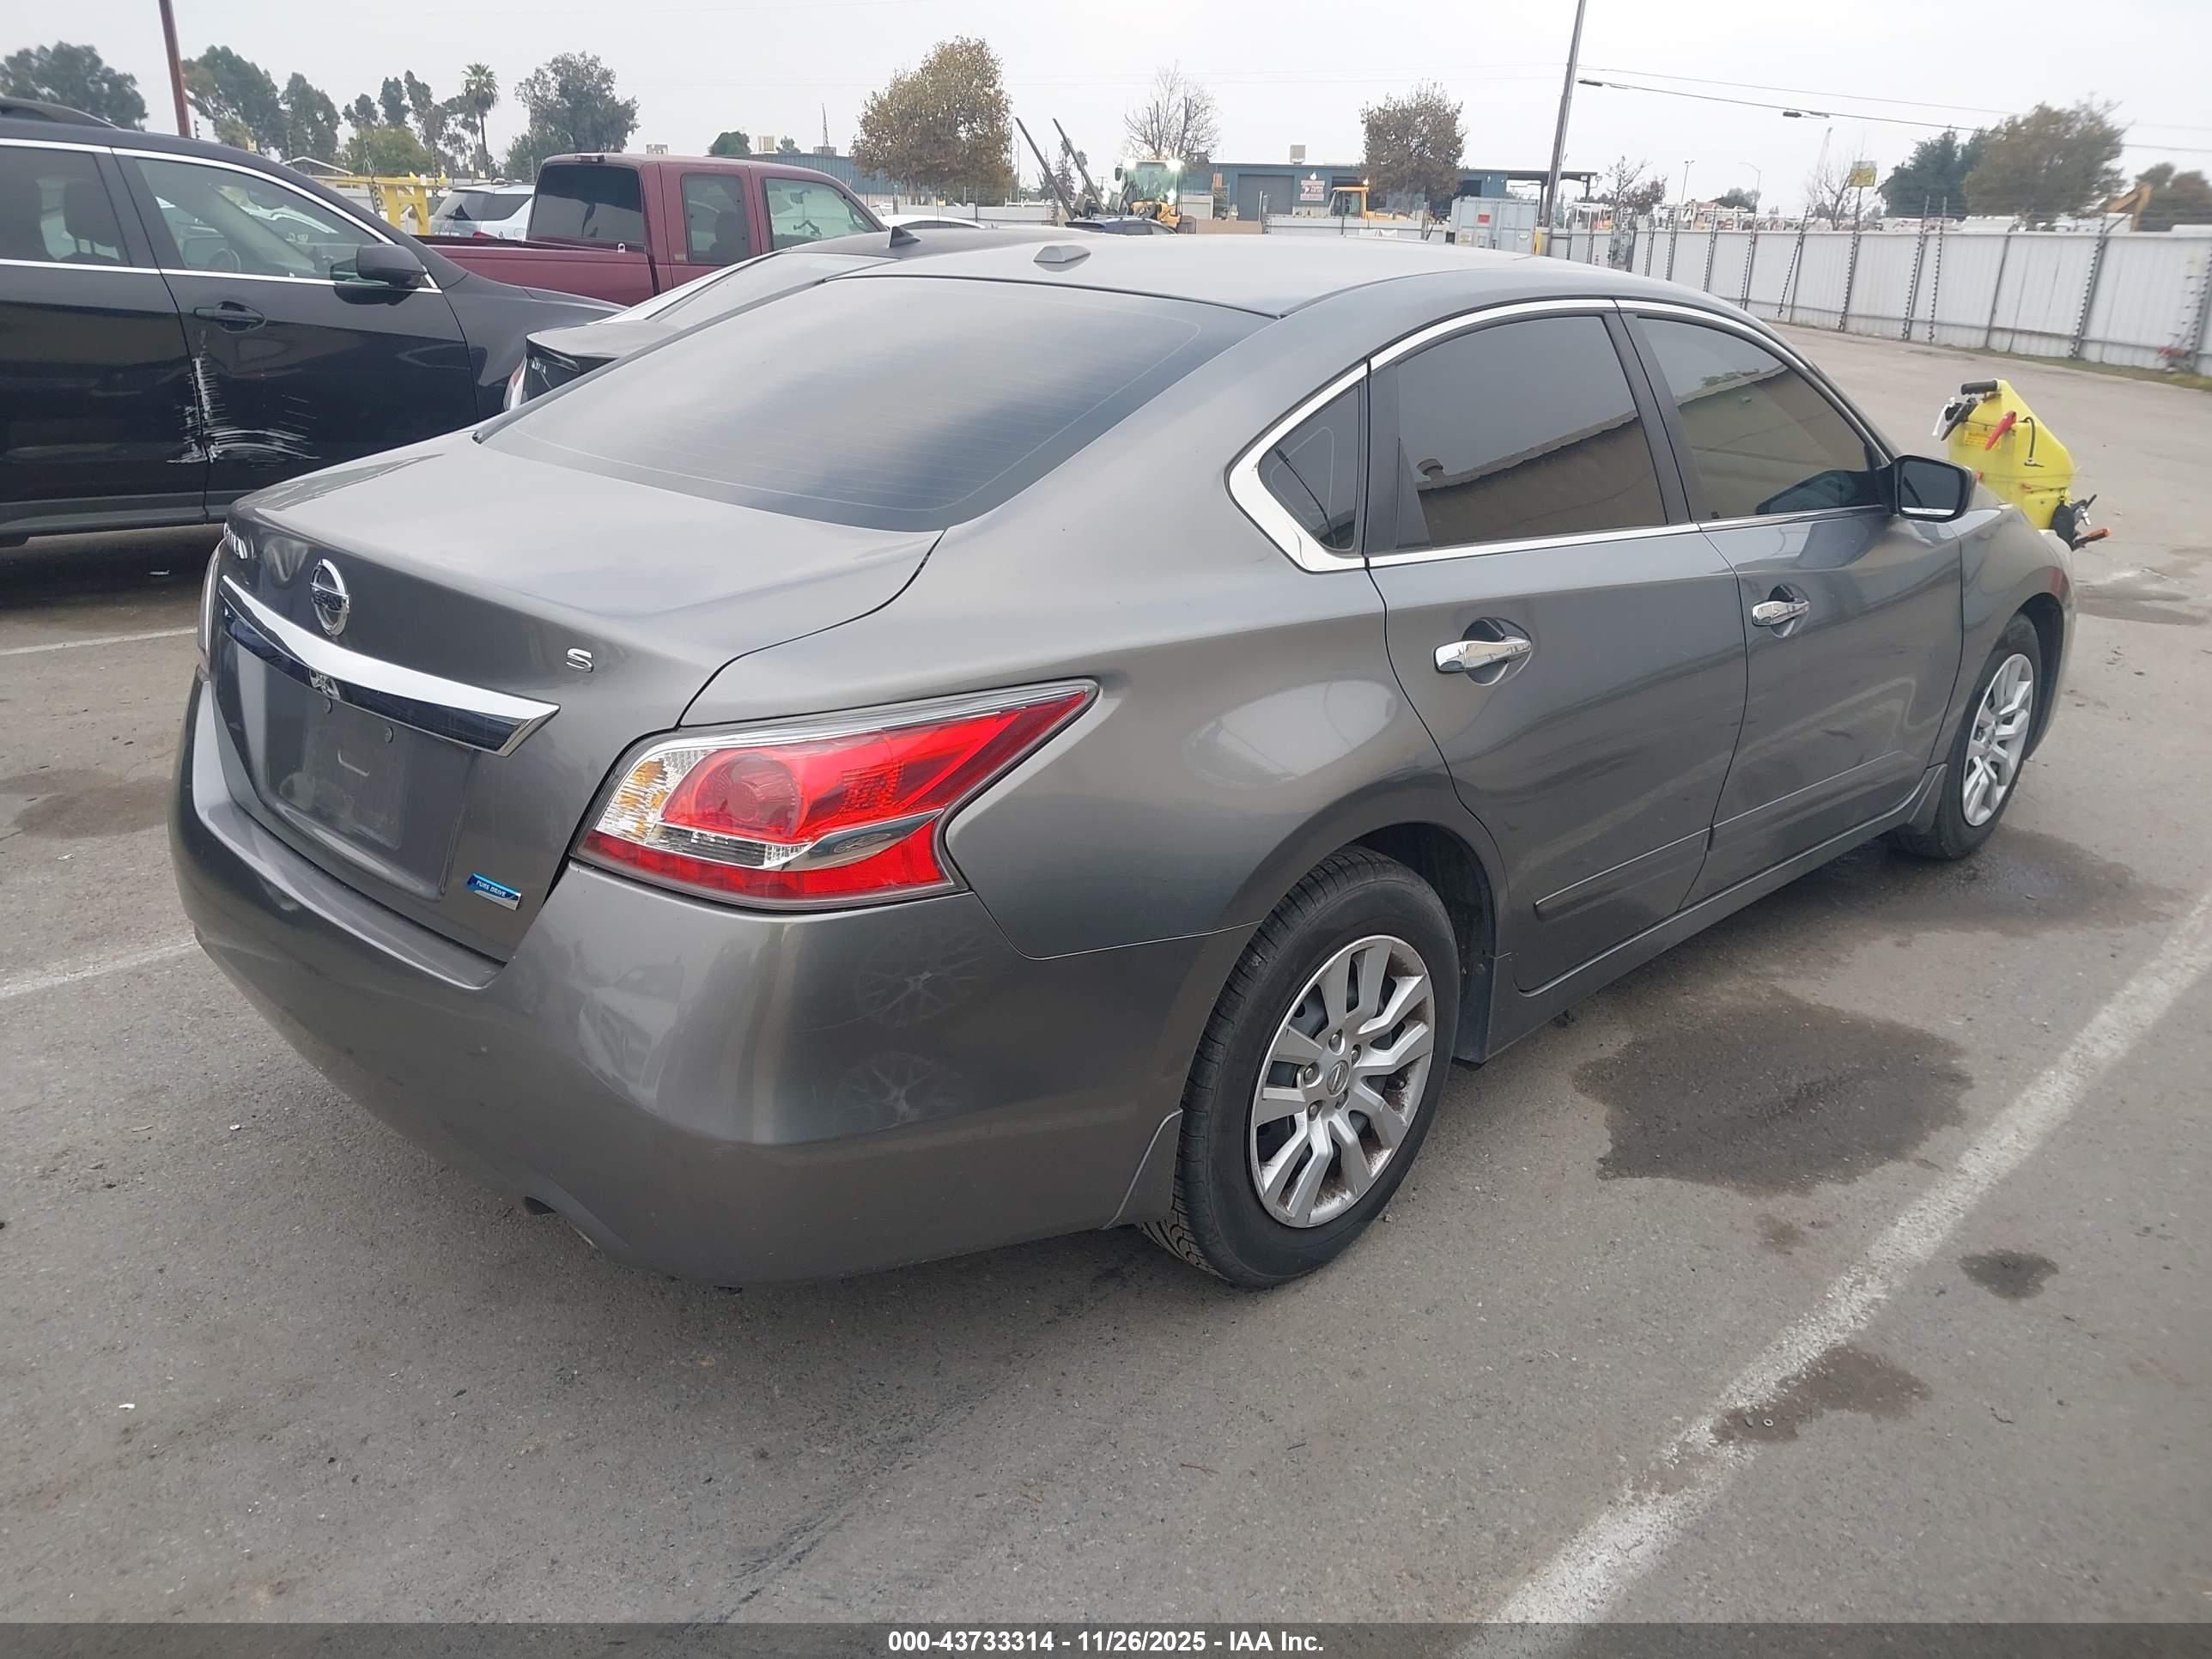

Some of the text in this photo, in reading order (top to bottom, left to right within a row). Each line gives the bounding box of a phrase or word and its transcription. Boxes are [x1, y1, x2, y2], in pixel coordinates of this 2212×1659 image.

[567, 648, 593, 672] S
[476, 880, 507, 897] PURE DRIVE
